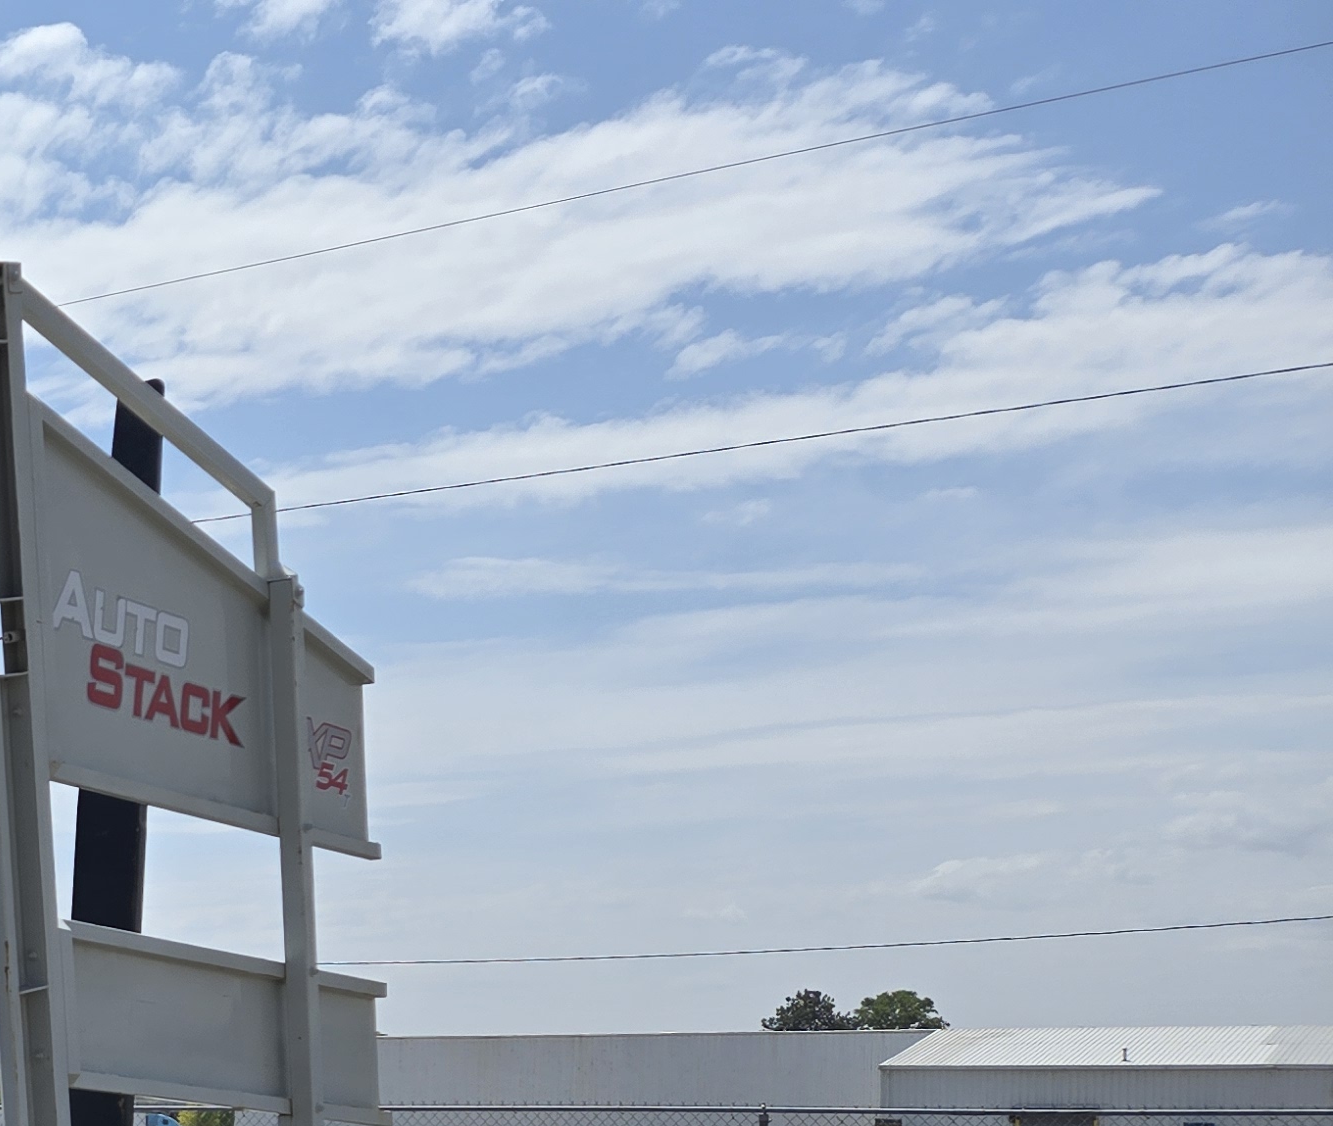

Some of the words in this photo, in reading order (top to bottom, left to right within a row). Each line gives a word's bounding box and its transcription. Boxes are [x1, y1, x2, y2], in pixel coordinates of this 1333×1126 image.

[52, 568, 190, 669] AUTO
[86, 643, 247, 749] STACK
[315, 761, 349, 796] 54
